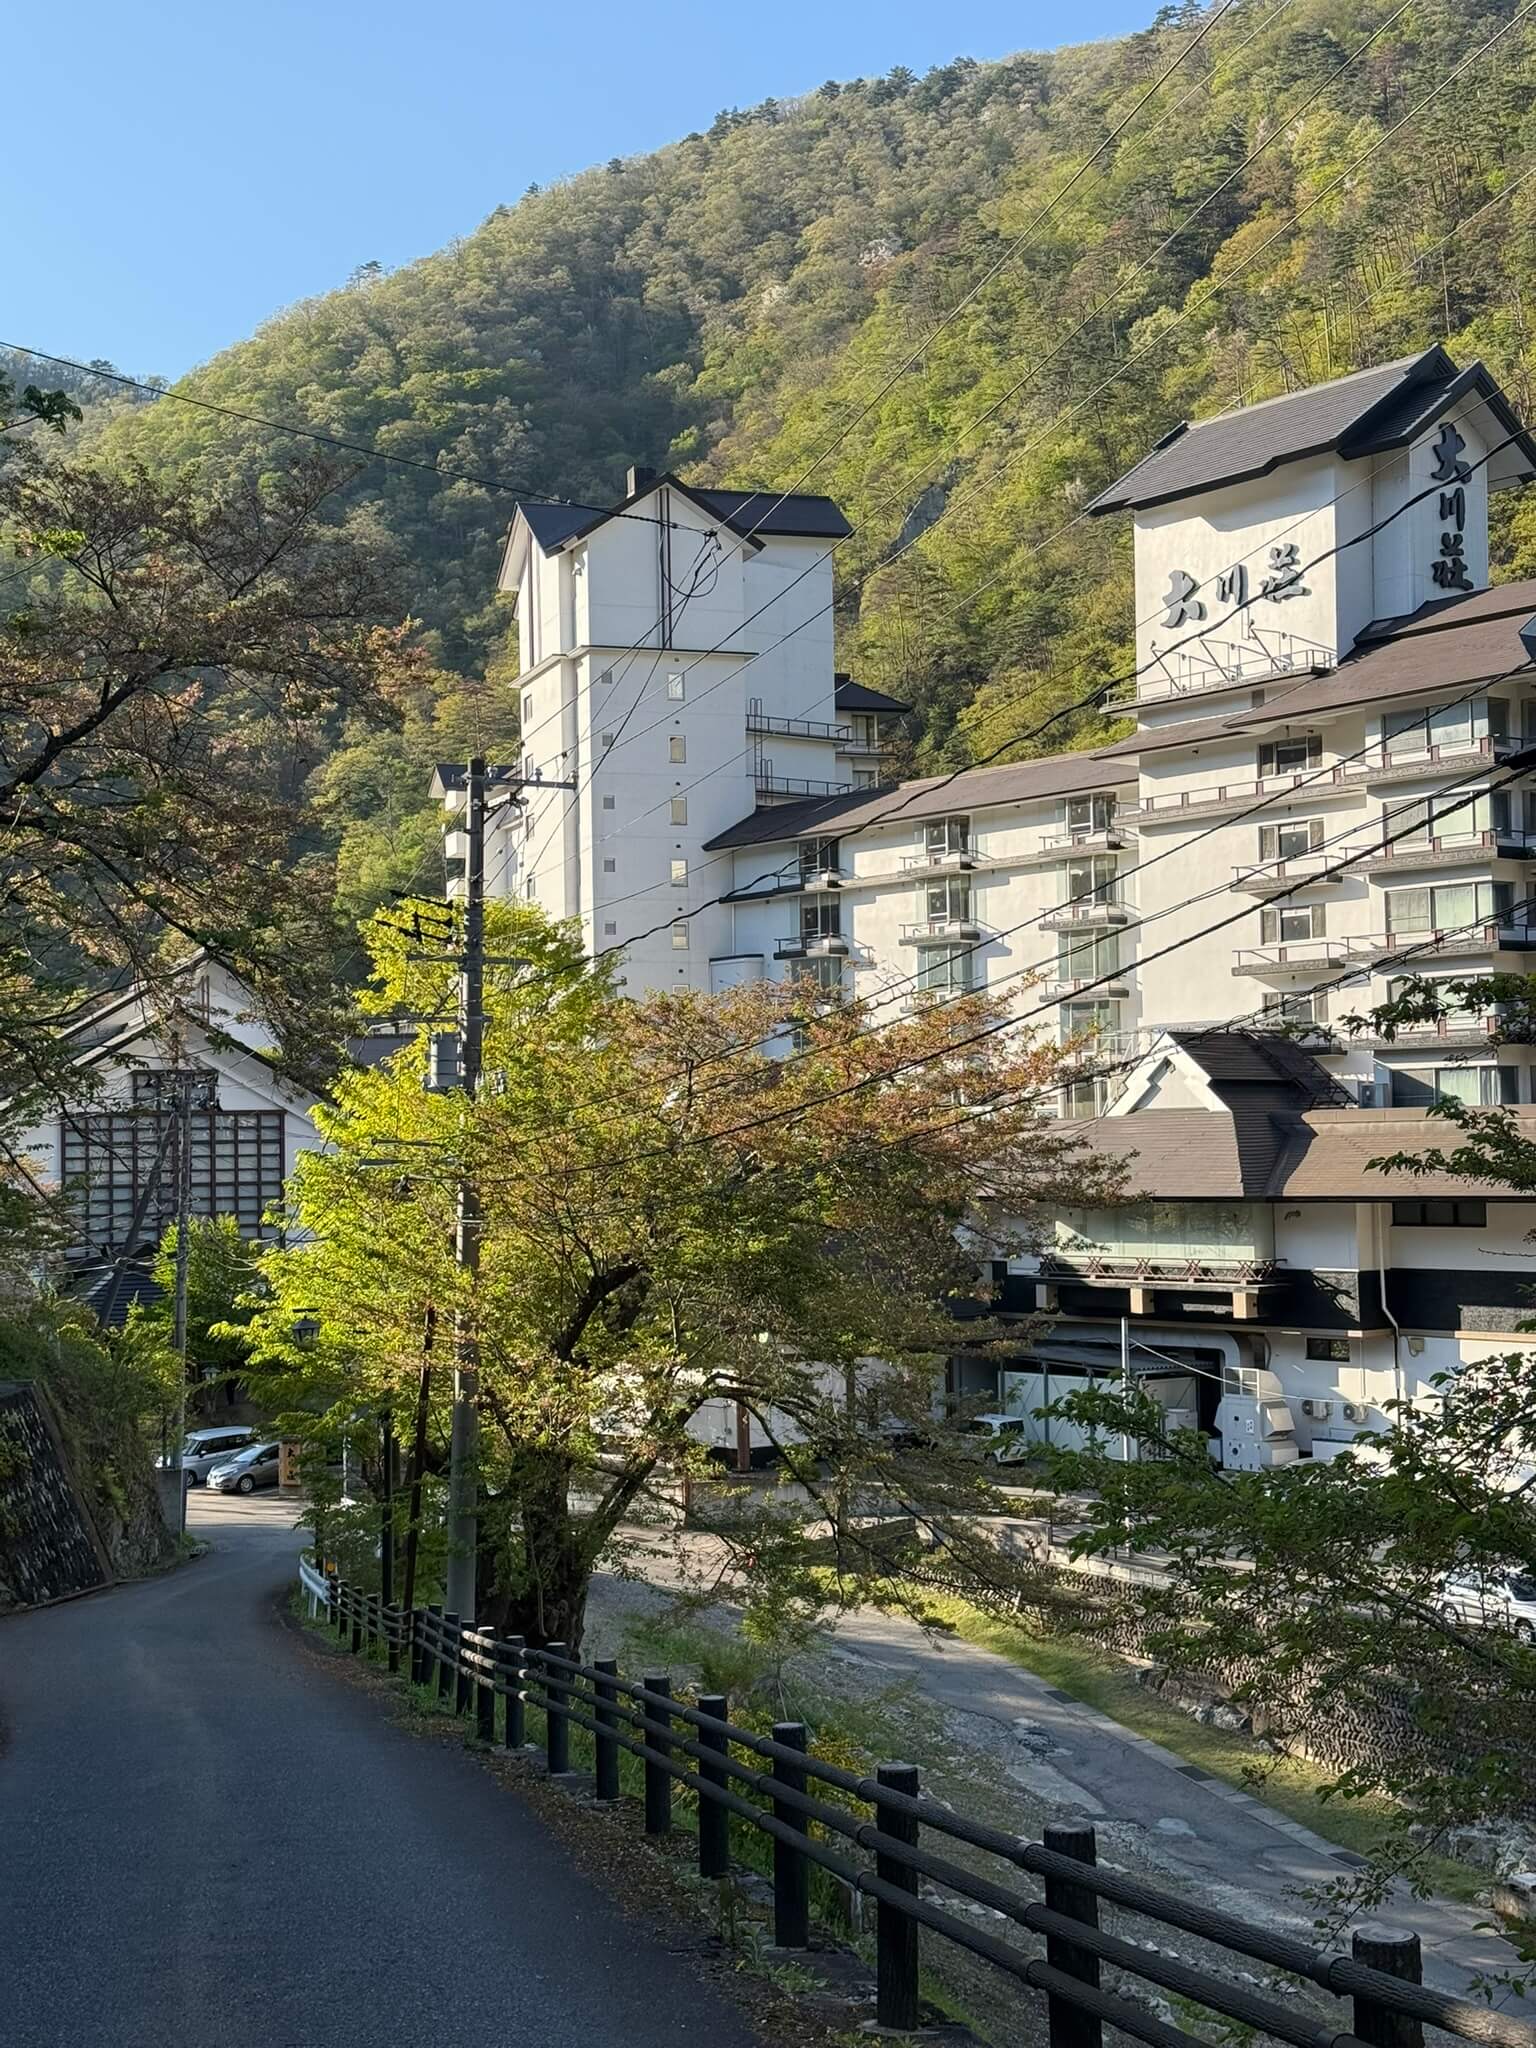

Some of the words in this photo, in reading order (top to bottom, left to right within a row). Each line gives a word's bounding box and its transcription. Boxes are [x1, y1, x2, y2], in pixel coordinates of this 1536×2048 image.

[1430, 422, 1474, 591] 大川荘
[1161, 543, 1312, 629] 大川荘
